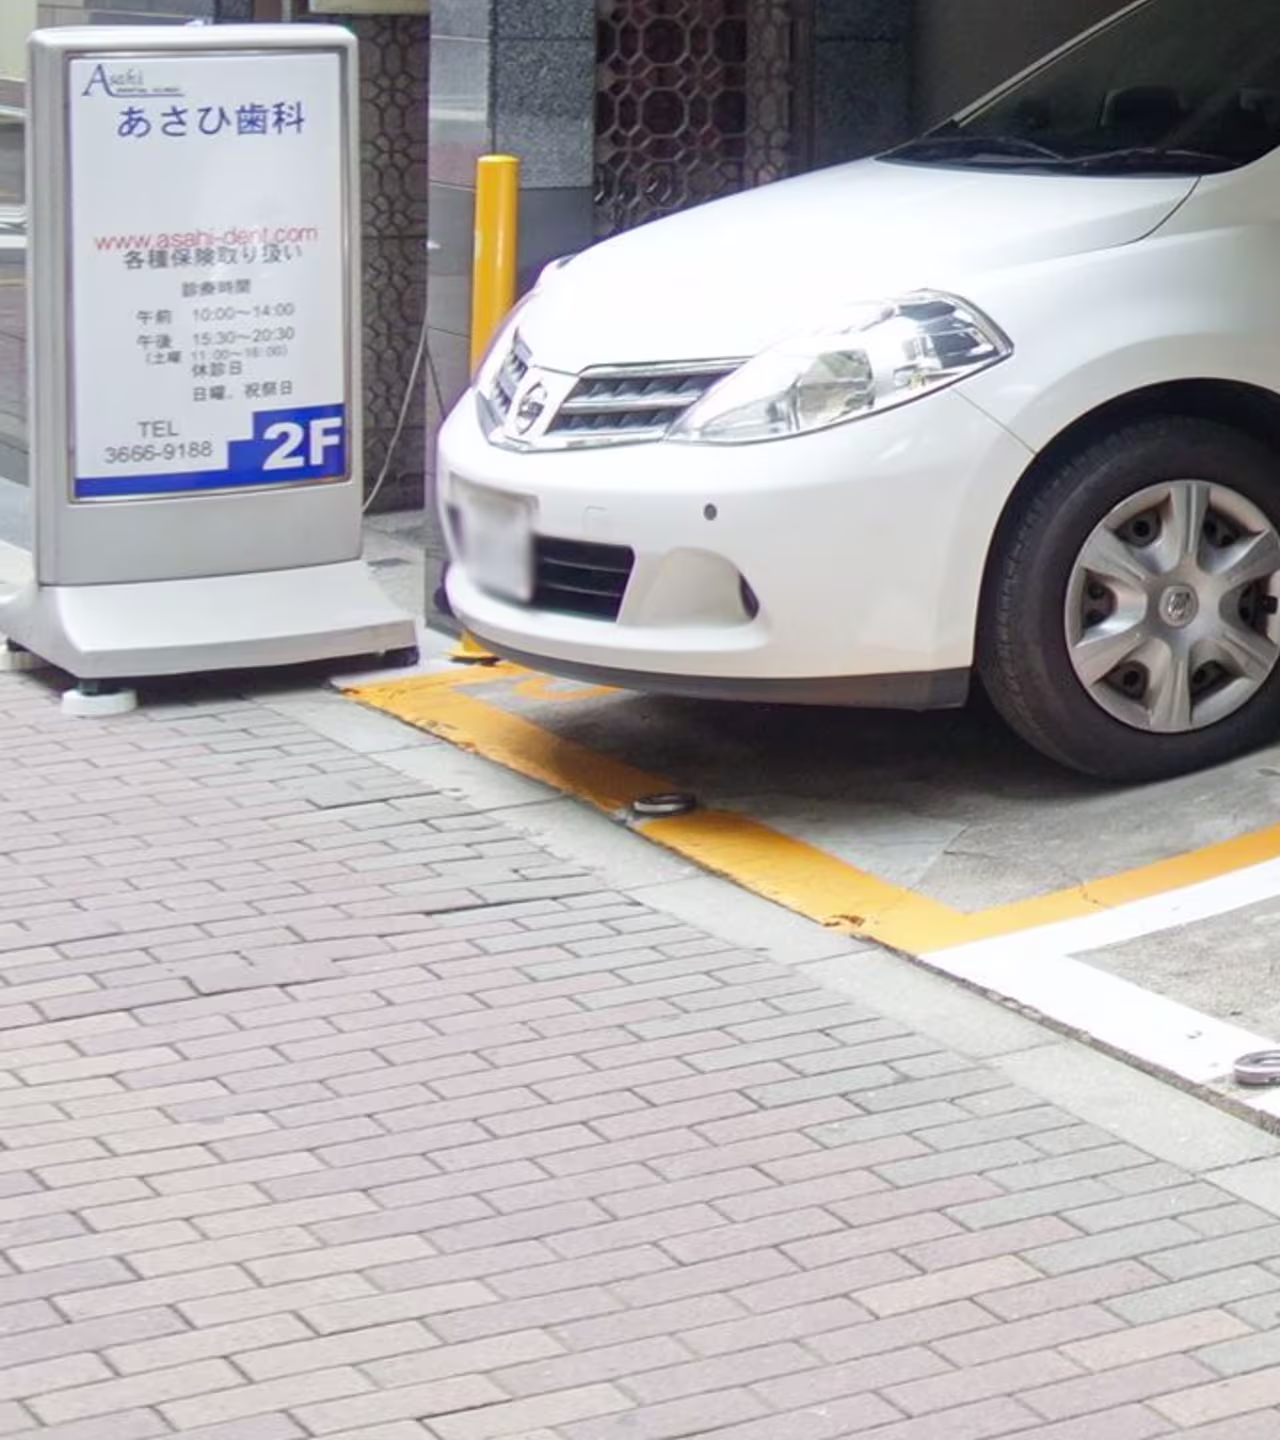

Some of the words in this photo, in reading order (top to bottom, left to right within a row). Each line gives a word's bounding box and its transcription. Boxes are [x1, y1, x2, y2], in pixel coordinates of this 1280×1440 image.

[118, 102, 305, 138] あさひ歯科
[94, 225, 318, 250] www.asahi-dent.com
[124, 244, 303, 270] 各種保険取り扱い
[182, 279, 251, 298] 診療時間
[136, 310, 172, 325] 午前
[136, 334, 171, 349] 午後
[192, 360, 242, 377] 休診日
[105, 440, 213, 464] 3666-9188
[138, 420, 179, 437] TEL
[262, 417, 342, 471] 2F
